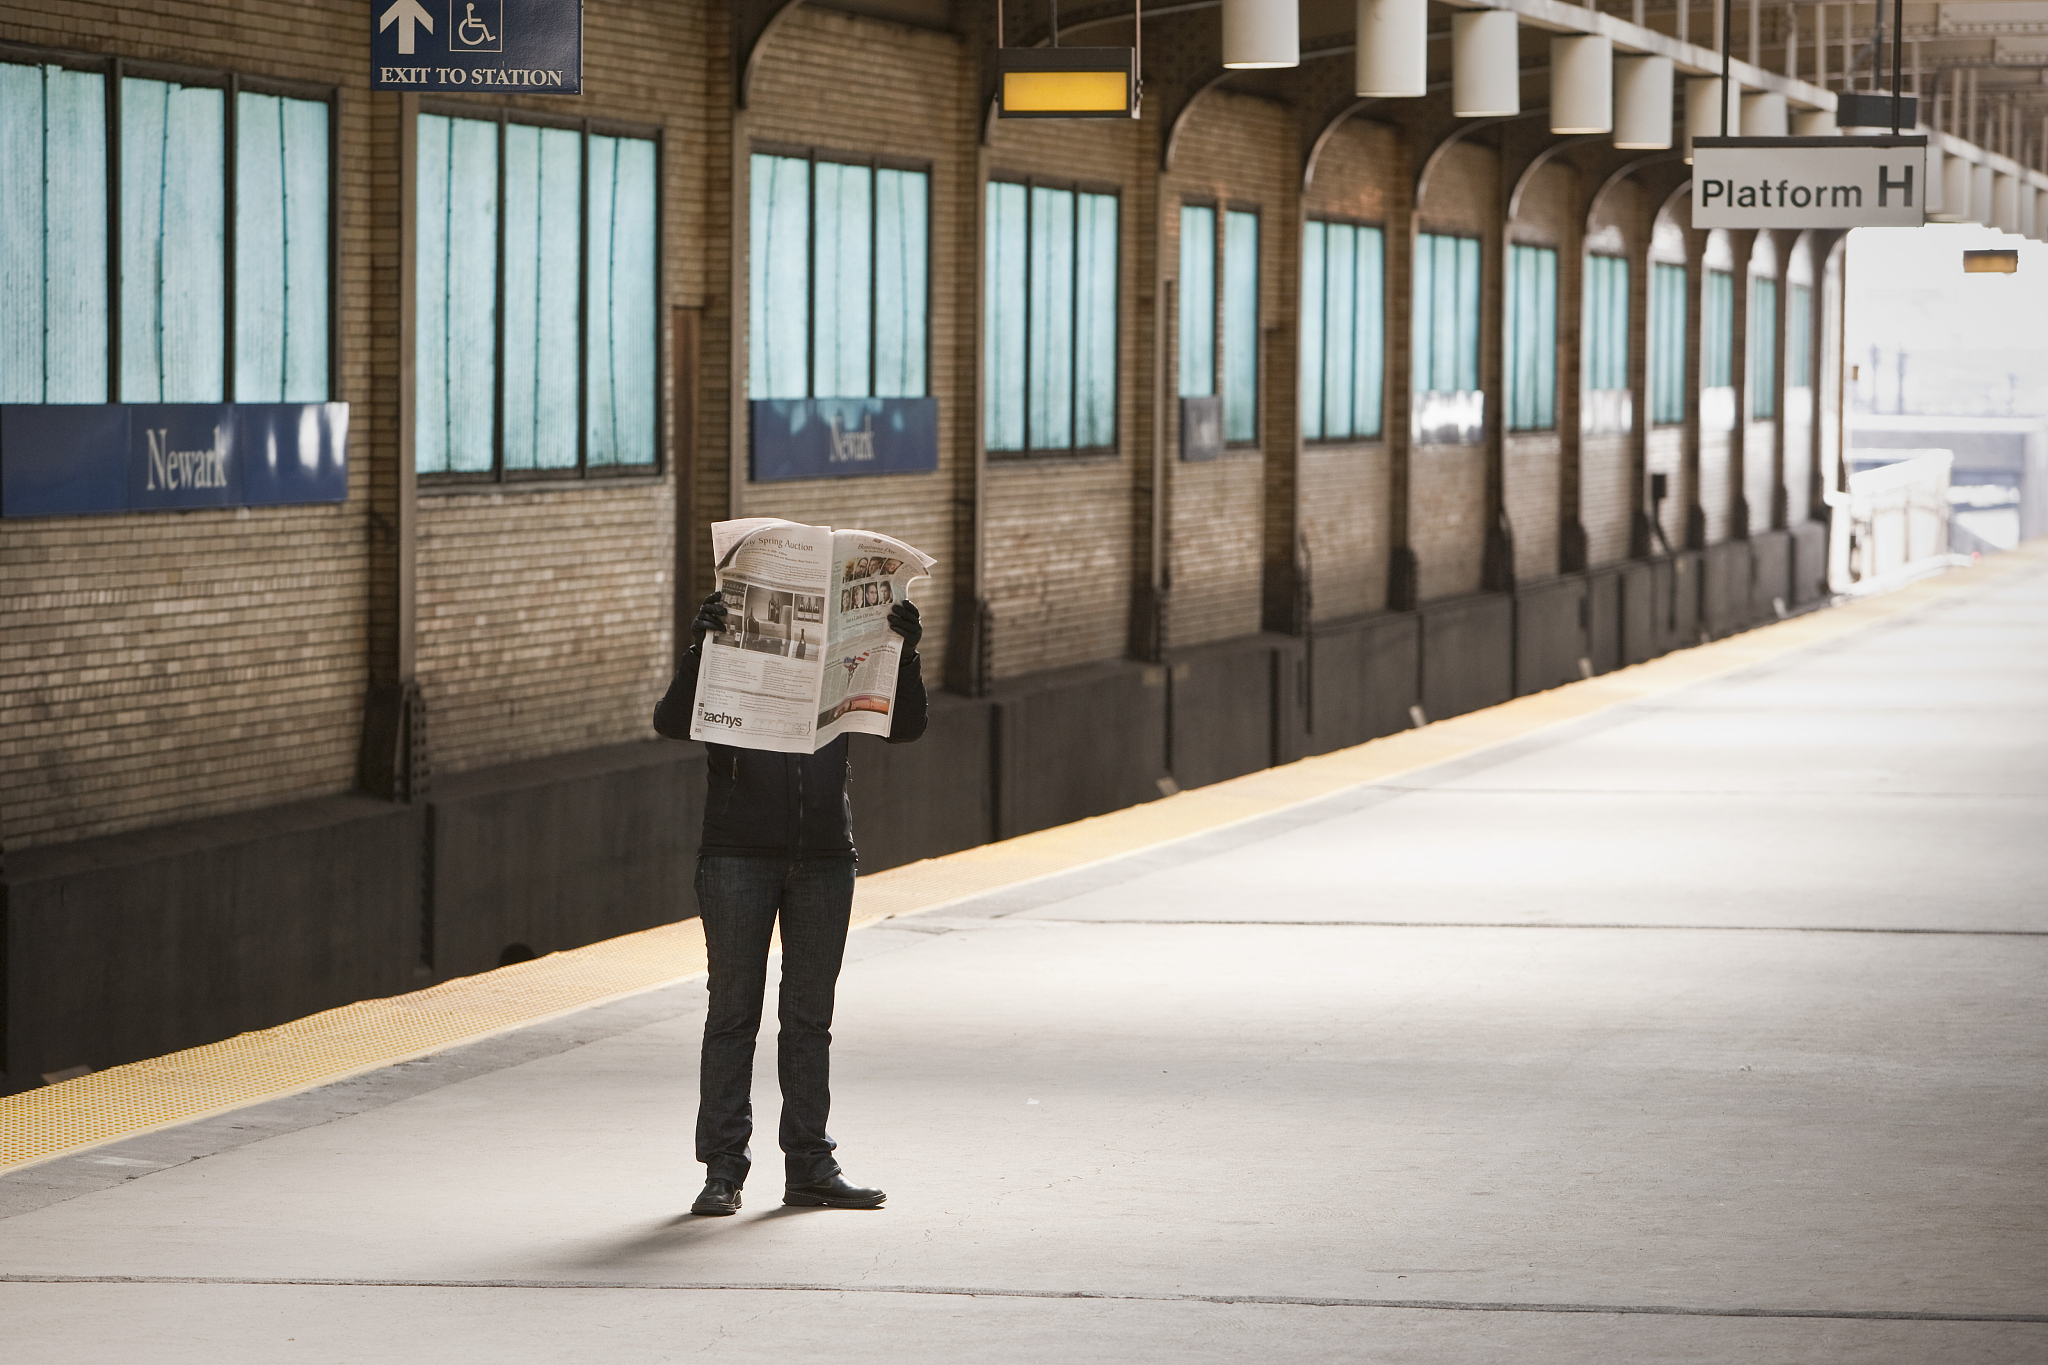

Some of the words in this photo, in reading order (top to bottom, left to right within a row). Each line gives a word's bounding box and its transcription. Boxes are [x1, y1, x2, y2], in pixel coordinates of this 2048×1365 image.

[380, 67, 430, 84] EXIT
[436, 68, 467, 85] TO
[471, 69, 563, 87] STATION
[1702, 179, 1862, 208] Platform
[1878, 165, 1913, 207] H
[829, 413, 876, 463] Newark
[146, 424, 228, 491] Newark
[758, 537, 783, 549] Spring
[784, 540, 813, 552] Auction
[703, 711, 743, 729] zachys
